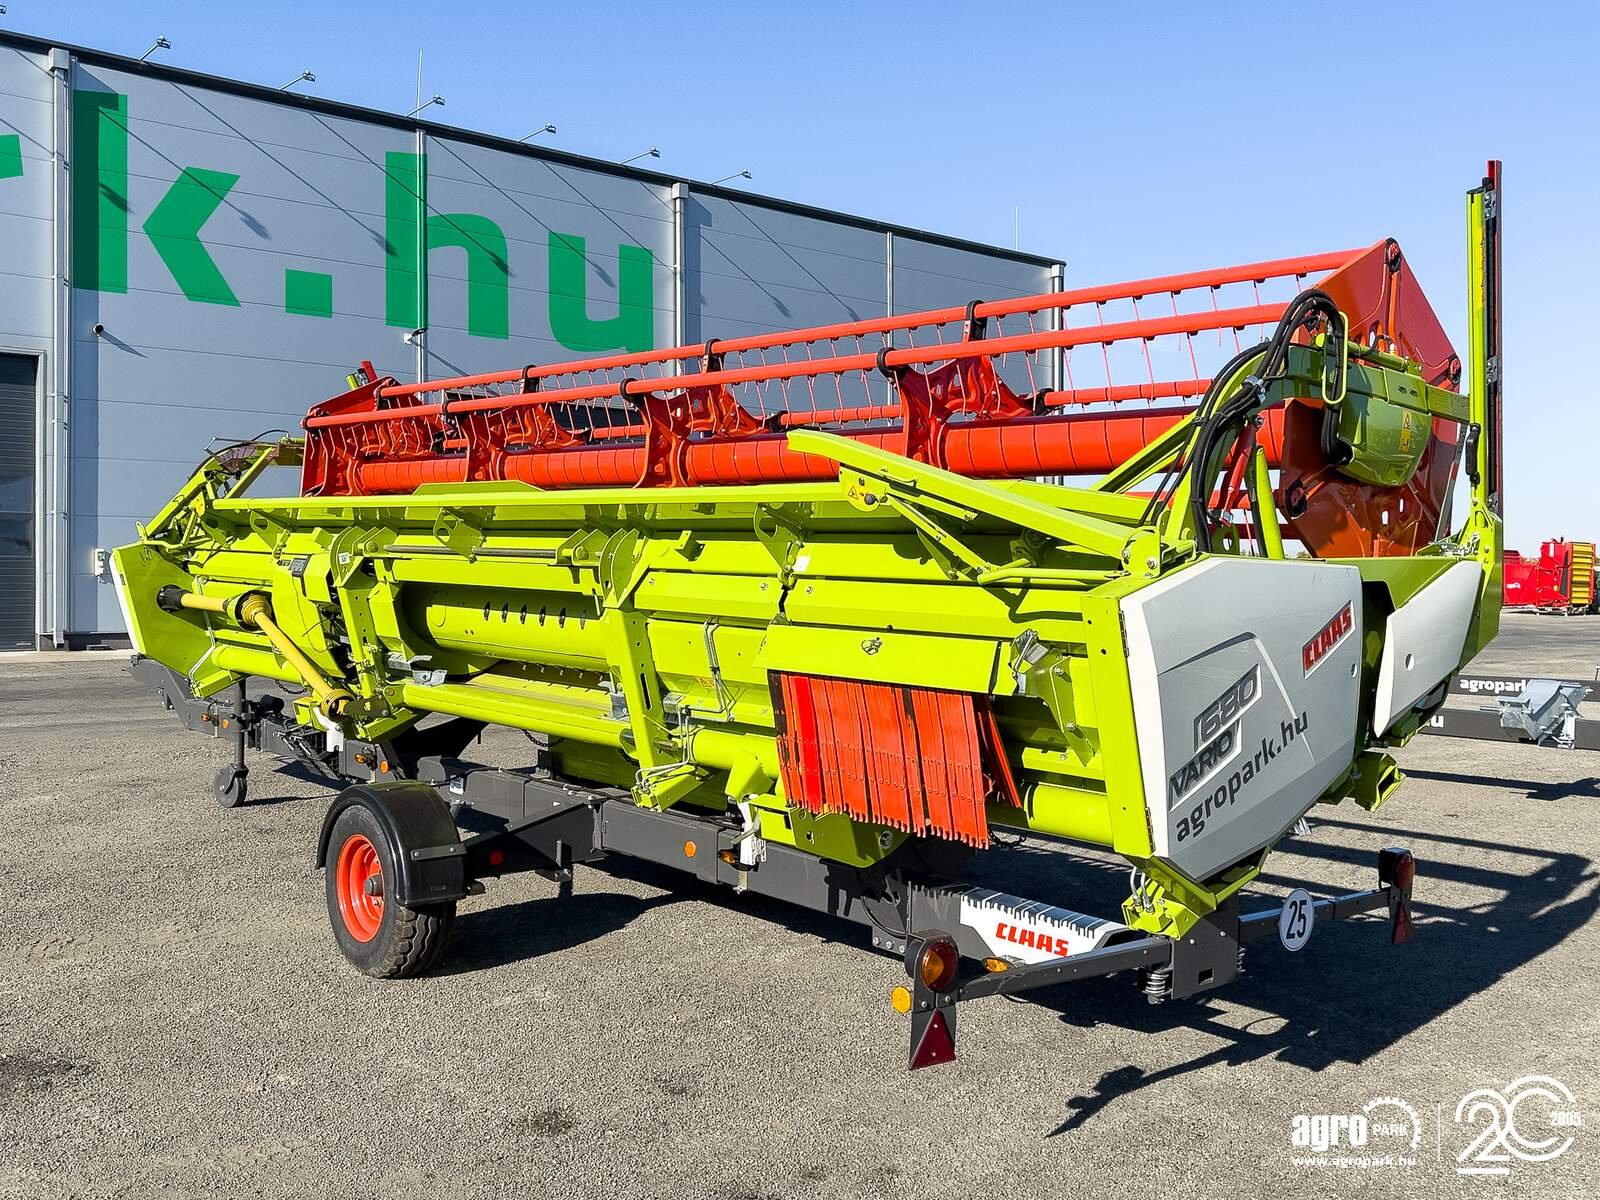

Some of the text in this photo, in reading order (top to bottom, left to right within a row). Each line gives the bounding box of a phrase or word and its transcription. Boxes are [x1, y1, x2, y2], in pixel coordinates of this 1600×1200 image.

[0, 89, 654, 353] k.hu
[1304, 606, 1352, 670] CLAAS
[1200, 671, 1258, 742] 680
[1170, 731, 1235, 797] VARIO
[1176, 711, 1308, 842] agropark.hu
[995, 922, 1069, 957] CLAAS
[1286, 899, 1307, 939] 25
